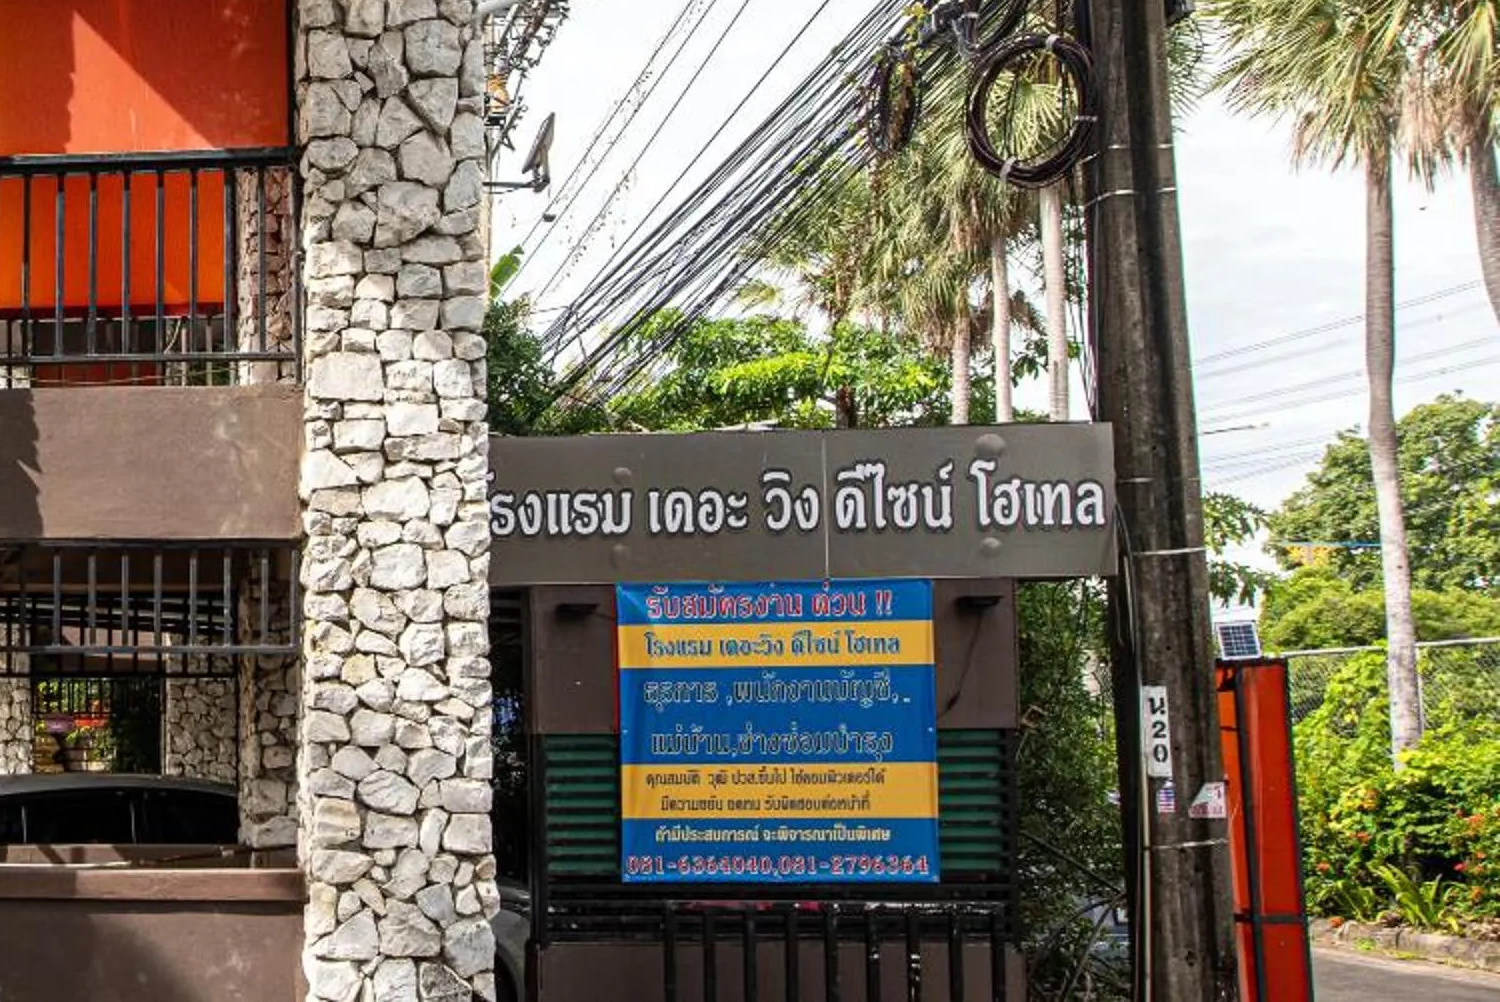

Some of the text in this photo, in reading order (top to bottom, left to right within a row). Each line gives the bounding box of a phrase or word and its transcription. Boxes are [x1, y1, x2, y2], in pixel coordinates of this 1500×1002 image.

[487, 458, 1106, 536] รงแรม เดอะ วิง ดีไซน์ โฮเทล
[645, 580, 893, 619] รับสมัครงาน ด่วน !!
[644, 631, 712, 657] โรงแรม
[791, 629, 841, 655] ดีไซน์
[845, 629, 900, 655] โฮเทล
[643, 680, 719, 711] ธุรการ
[651, 722, 894, 762] แม่บ้าน,ช่างซ่อมบำรุง
